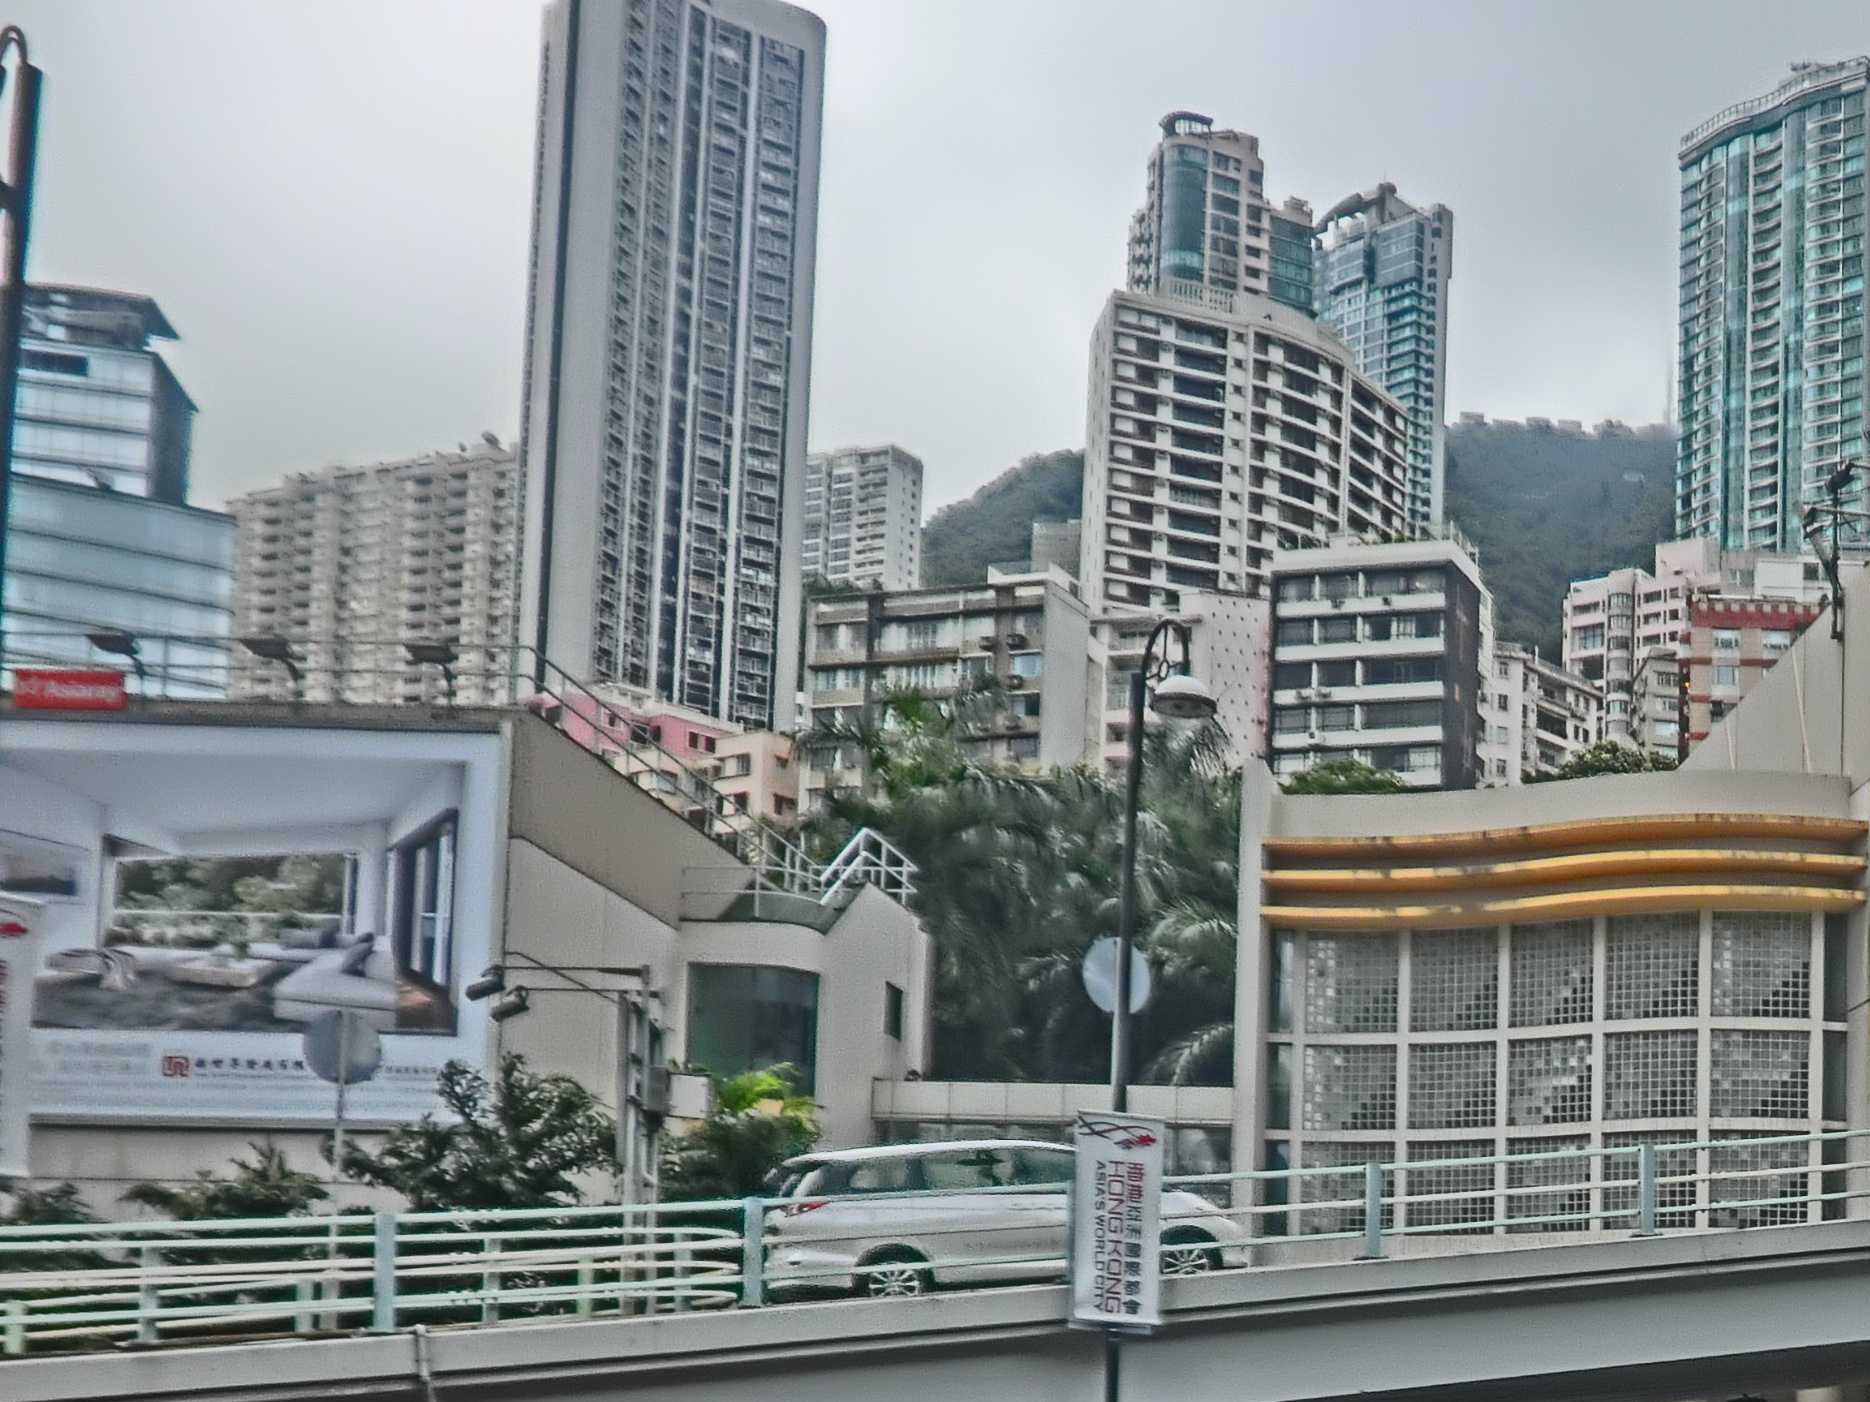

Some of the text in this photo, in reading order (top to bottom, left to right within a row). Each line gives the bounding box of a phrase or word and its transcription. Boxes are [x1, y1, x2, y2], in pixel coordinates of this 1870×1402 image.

[1093, 1160, 1106, 1312] ASIA'S WORLD CITY
[1105, 1160, 1125, 1314] HONG KONG
